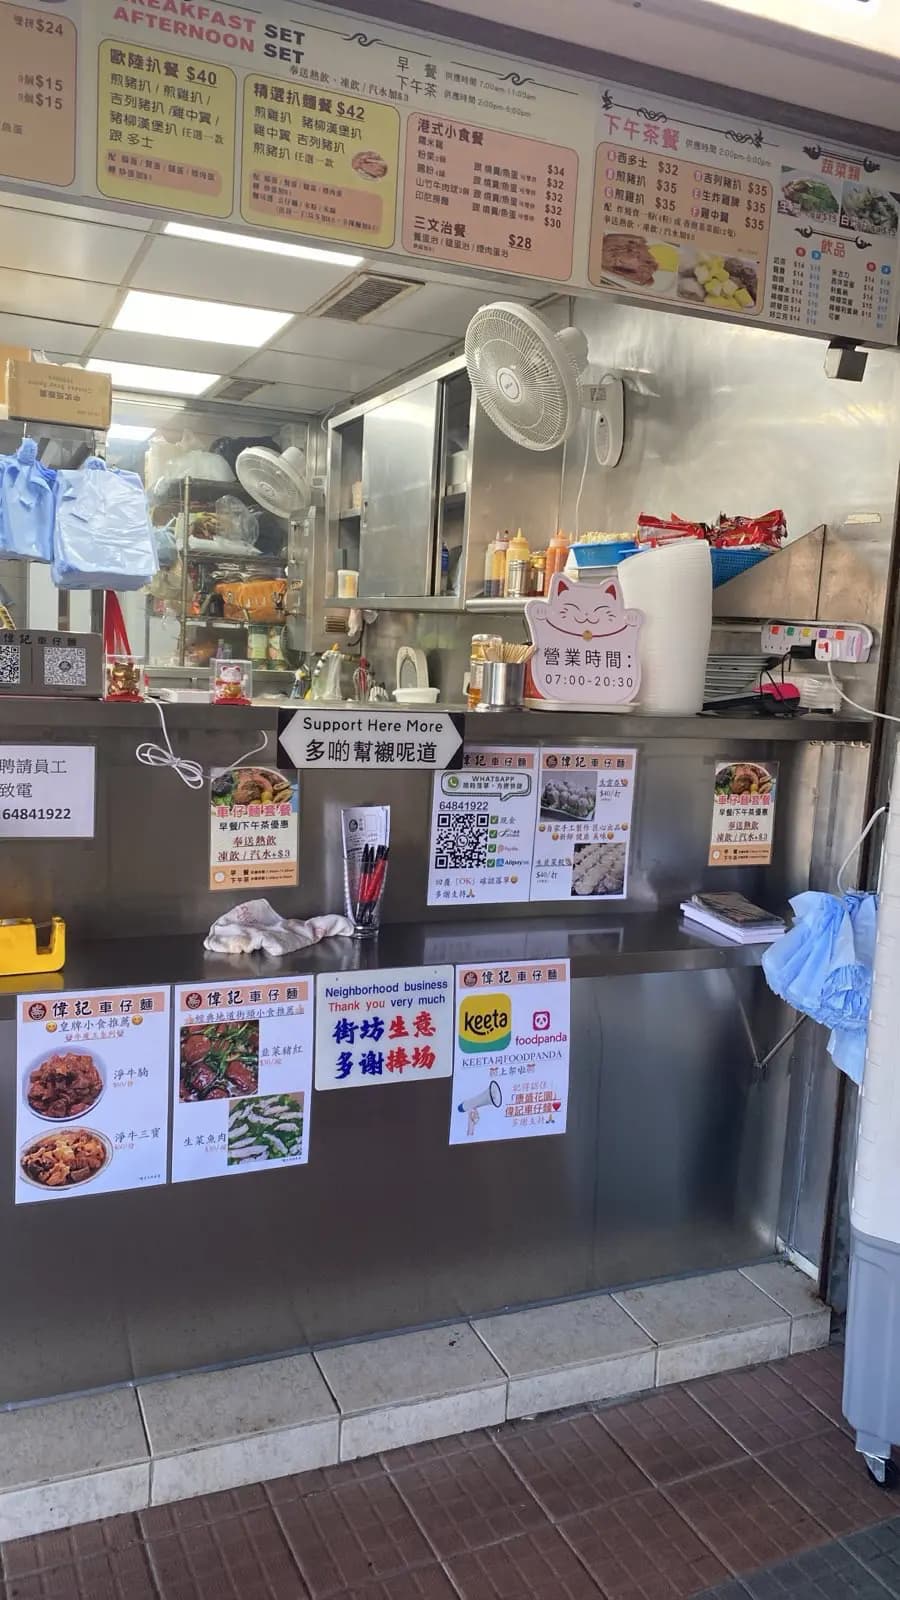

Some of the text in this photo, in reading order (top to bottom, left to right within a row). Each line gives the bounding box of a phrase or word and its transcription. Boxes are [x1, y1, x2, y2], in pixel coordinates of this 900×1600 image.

[112, 7, 306, 65] AFTERNOON SET
[263, 24, 306, 46] SET
[109, 48, 218, 86] 歐陸扒餐 $40
[110, 72, 152, 94] 煎豬扒
[396, 75, 437, 97] 下午茶
[110, 92, 166, 114] 吉列豬扒
[336, 101, 366, 121] $42
[109, 110, 178, 137] 豬柳漢堡扒
[254, 105, 363, 140] 煎雞扒 豬柳漢堡扒
[418, 118, 484, 146] 港式小食餐
[603, 112, 680, 151] 下午茶餐
[127, 131, 154, 149] 多士
[297, 133, 346, 155] 吉列豬扒
[252, 142, 291, 161] 煎豬扒
[547, 164, 565, 176] $34
[616, 152, 769, 197] 西多士 $32 吉列豬扒 $35
[546, 178, 564, 190] $32
[615, 171, 647, 189] 煎豬扒
[656, 179, 678, 195] $35
[746, 198, 767, 214] $35
[545, 191, 563, 203] $32
[544, 203, 562, 216] $32
[614, 187, 645, 205] 煎雞扒
[655, 197, 676, 212] $35
[744, 216, 765, 231] $35
[543, 216, 561, 229] $30
[413, 216, 532, 250] 三文治餐 $28
[821, 239, 846, 259] 飲品
[545, 673, 634, 688] 07:00-20:30
[302, 716, 444, 733] Support Here More
[305, 738, 437, 764] 多啲幫襯呢道
[0, 757, 68, 775] 聘請員工
[0, 781, 33, 799] 致電
[2, 807, 72, 821] 64841922
[217, 803, 292, 818] 車仔麵套餐
[439, 801, 489, 811] 64841922
[233, 835, 277, 848] 奉送熱飲
[482, 969, 557, 985] 偉記車仔麵
[207, 987, 299, 1006] 偉記車仔麵
[325, 979, 448, 999] Neighborhood business
[52, 998, 153, 1018] 偉記車仔麵
[328, 993, 445, 1013] Thank you very much
[332, 1010, 437, 1045] 街坊生意
[464, 1009, 508, 1034] keeta
[515, 1032, 567, 1047] foodpanda
